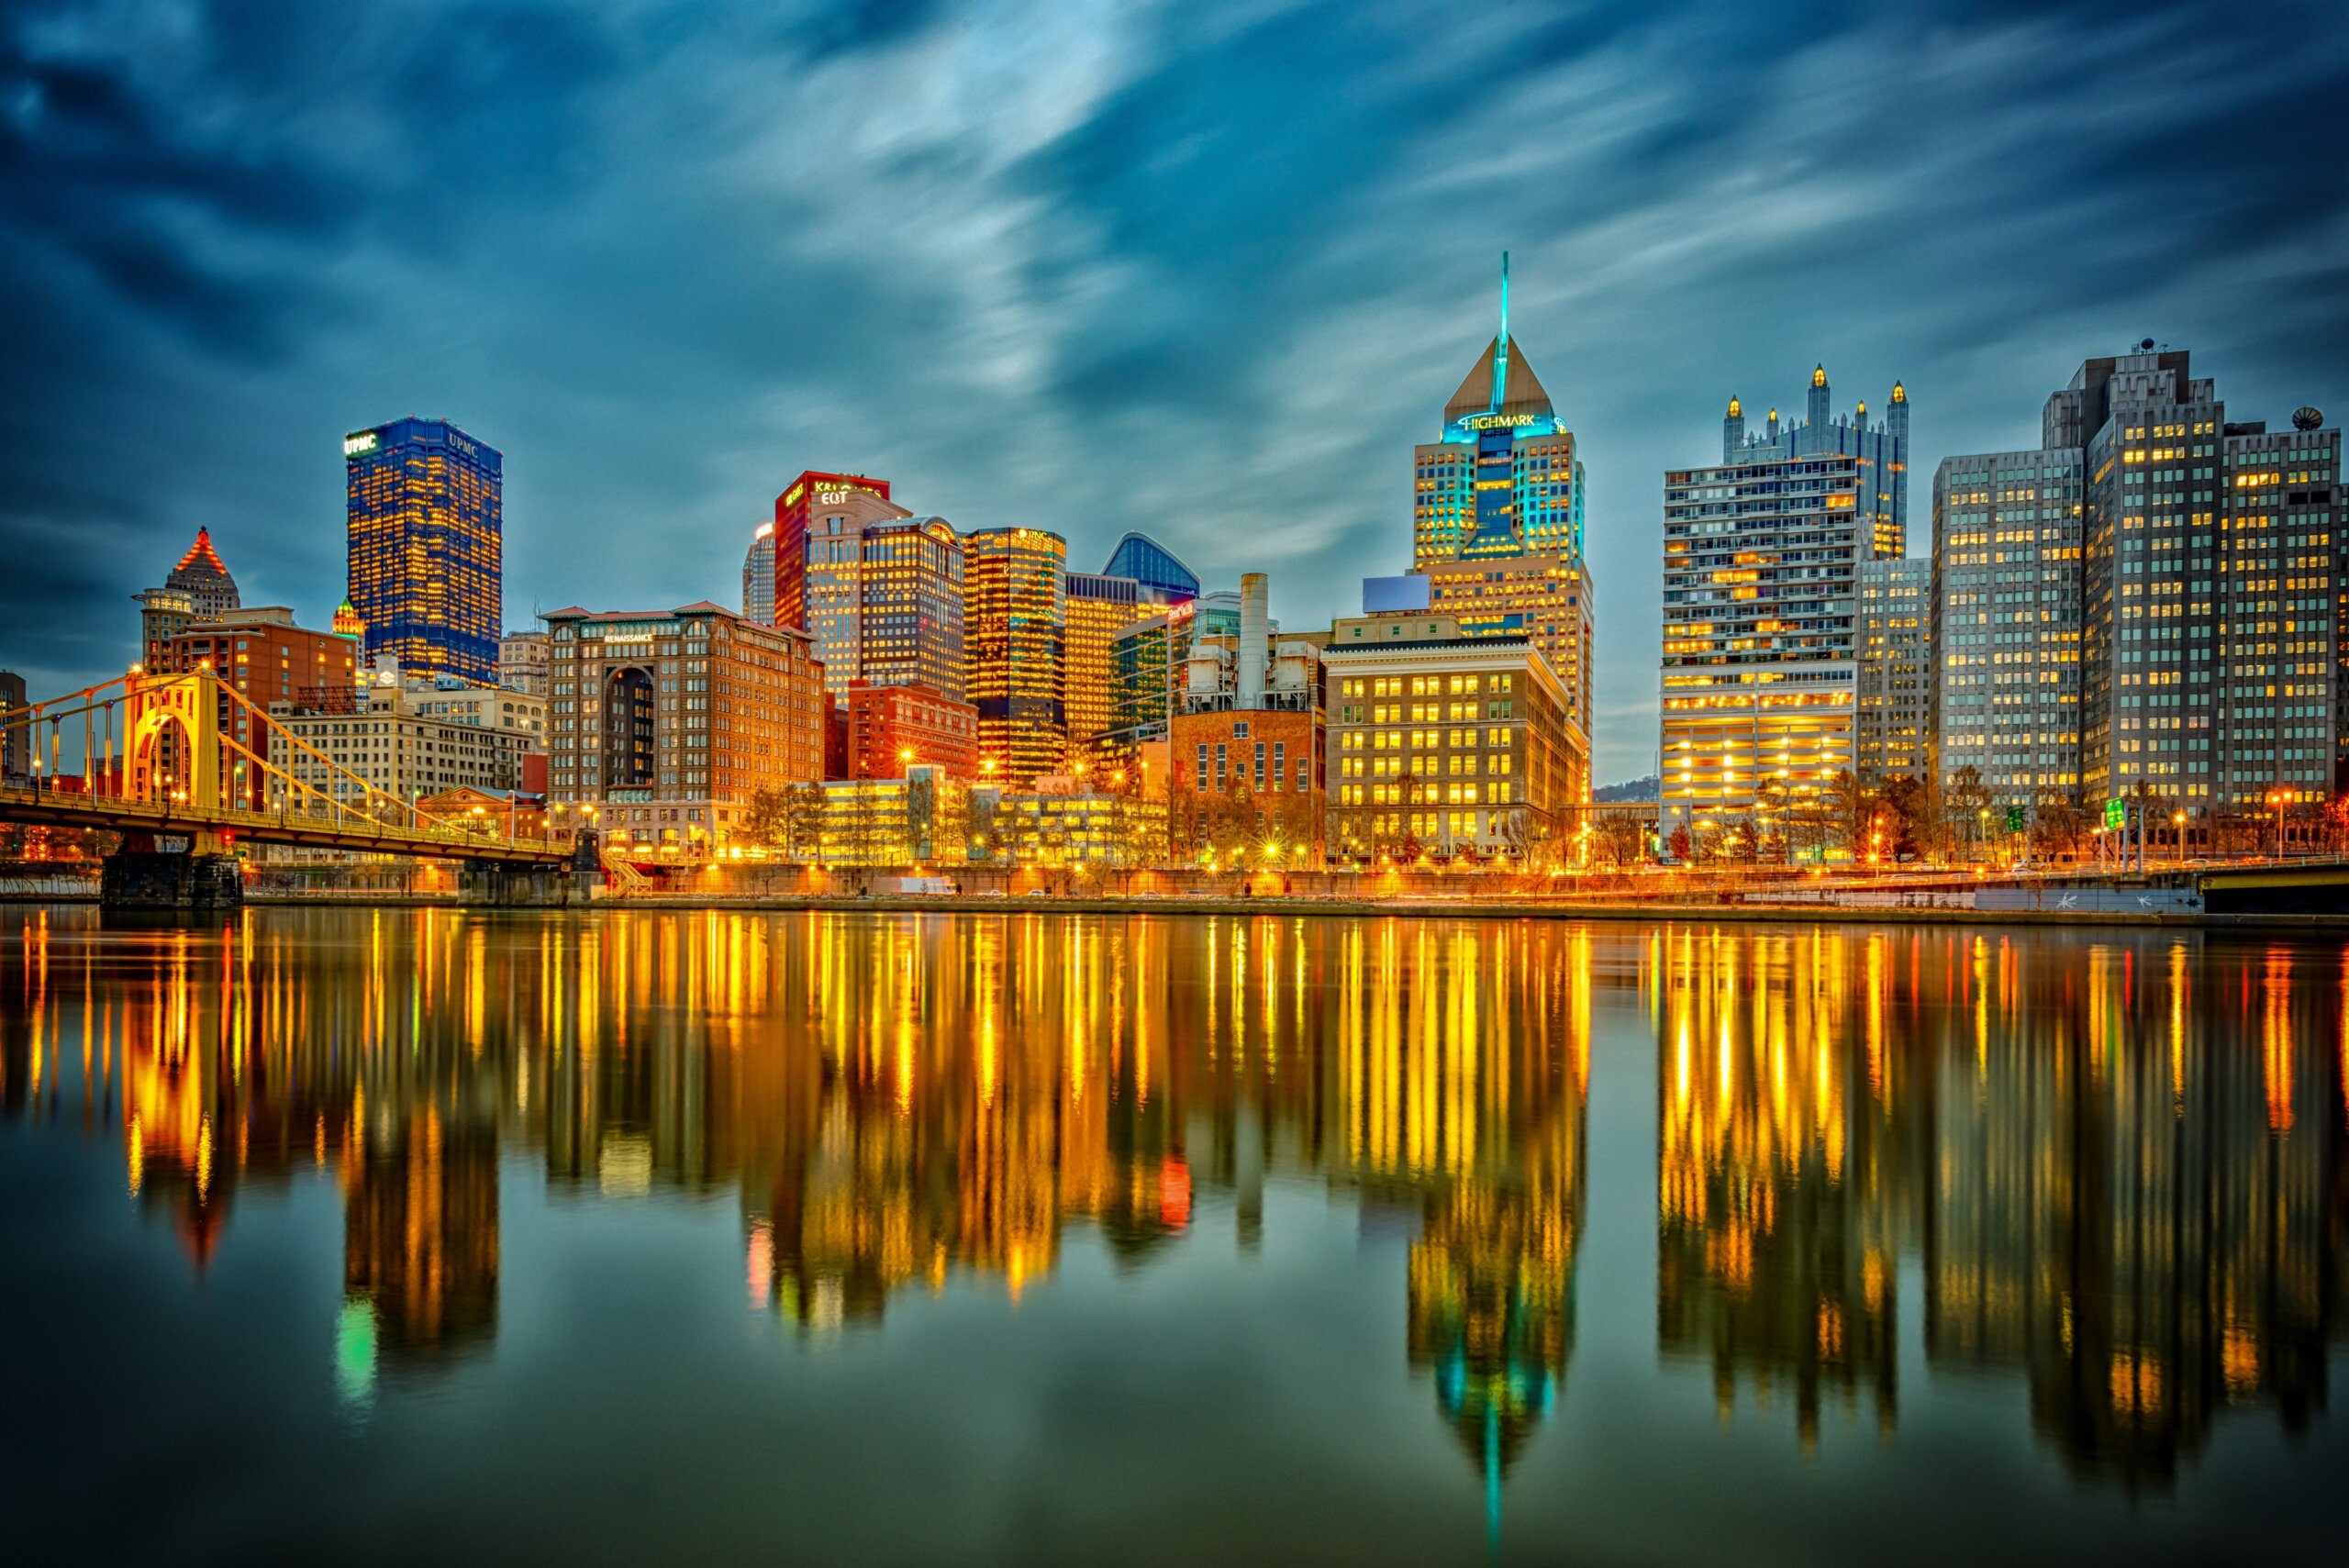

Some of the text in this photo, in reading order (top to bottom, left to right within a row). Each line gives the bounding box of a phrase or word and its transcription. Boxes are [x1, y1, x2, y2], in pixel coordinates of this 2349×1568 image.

[1464, 415, 1535, 431] HIGHMARK
[344, 434, 376, 454] UPMC
[449, 433, 478, 458] UPMC
[821, 491, 848, 505] EQT
[604, 634, 652, 642] RENAISSANCE
